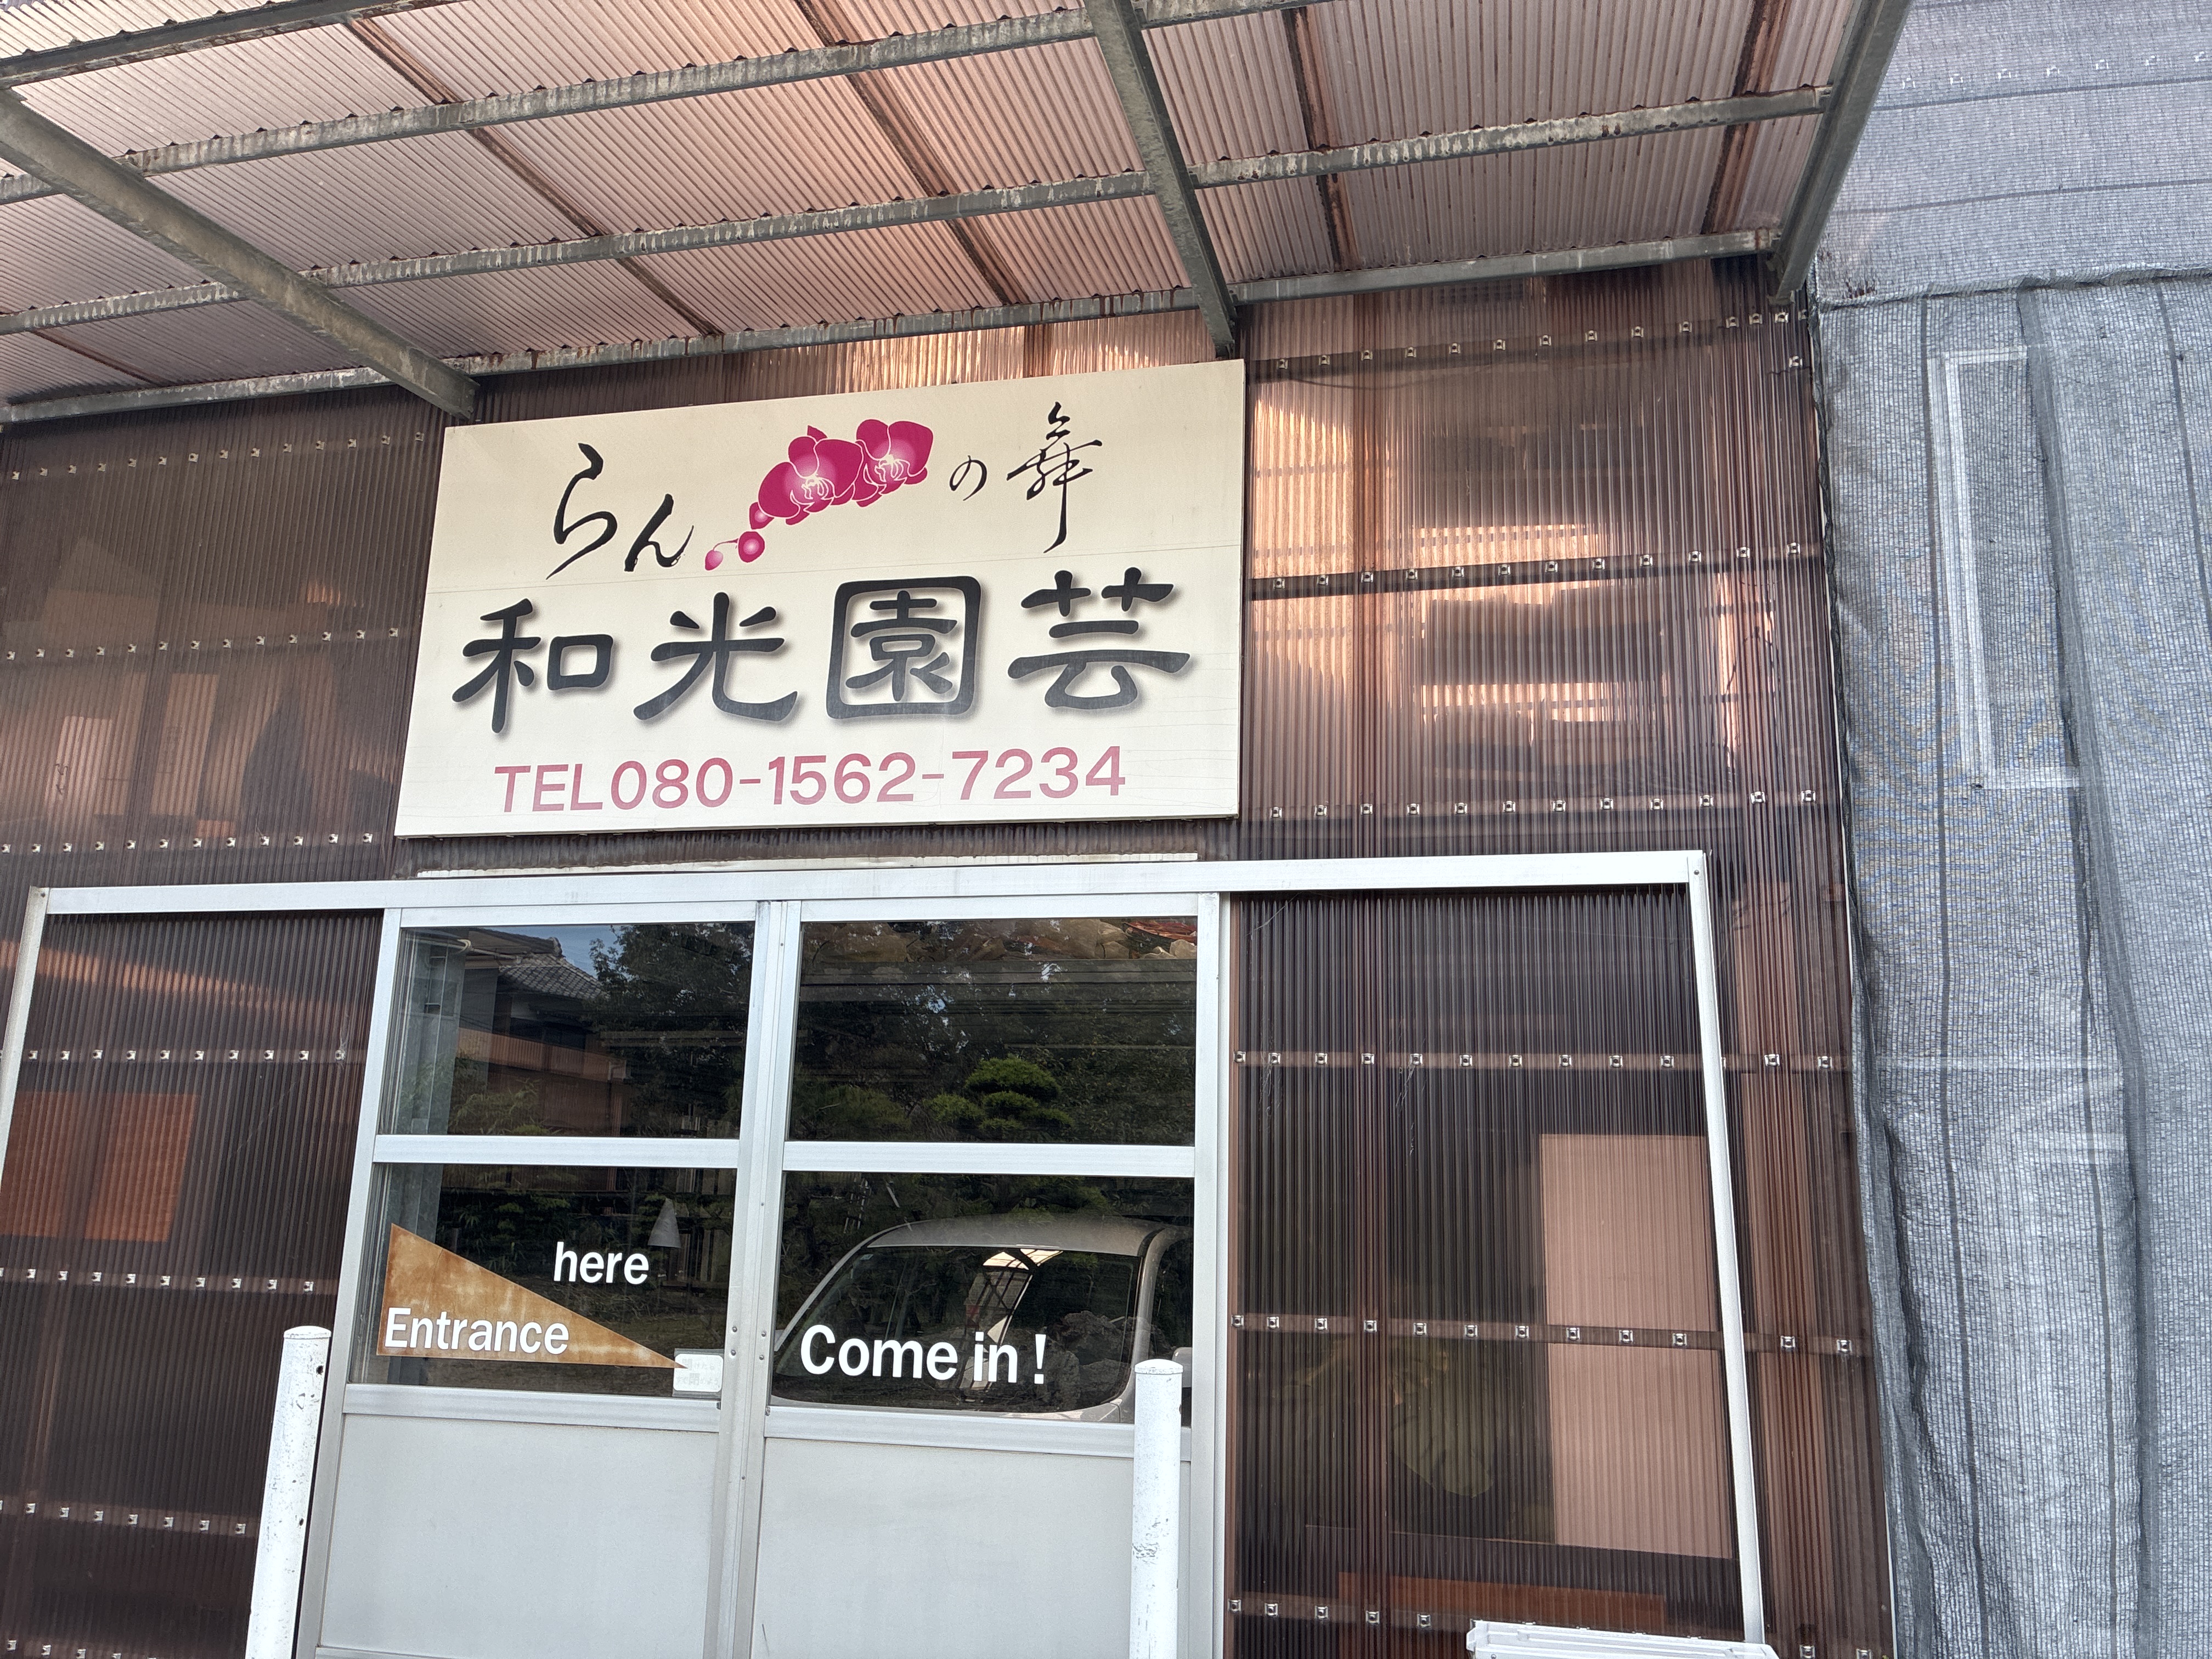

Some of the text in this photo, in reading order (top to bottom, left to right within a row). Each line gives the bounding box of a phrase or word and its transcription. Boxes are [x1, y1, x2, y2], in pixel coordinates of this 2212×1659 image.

[545, 442, 695, 580] らん
[452, 566, 1191, 735] 和光園芸
[553, 1241, 650, 1285] here
[384, 1307, 569, 1355] Entrance
[800, 1324, 958, 1381] Come
